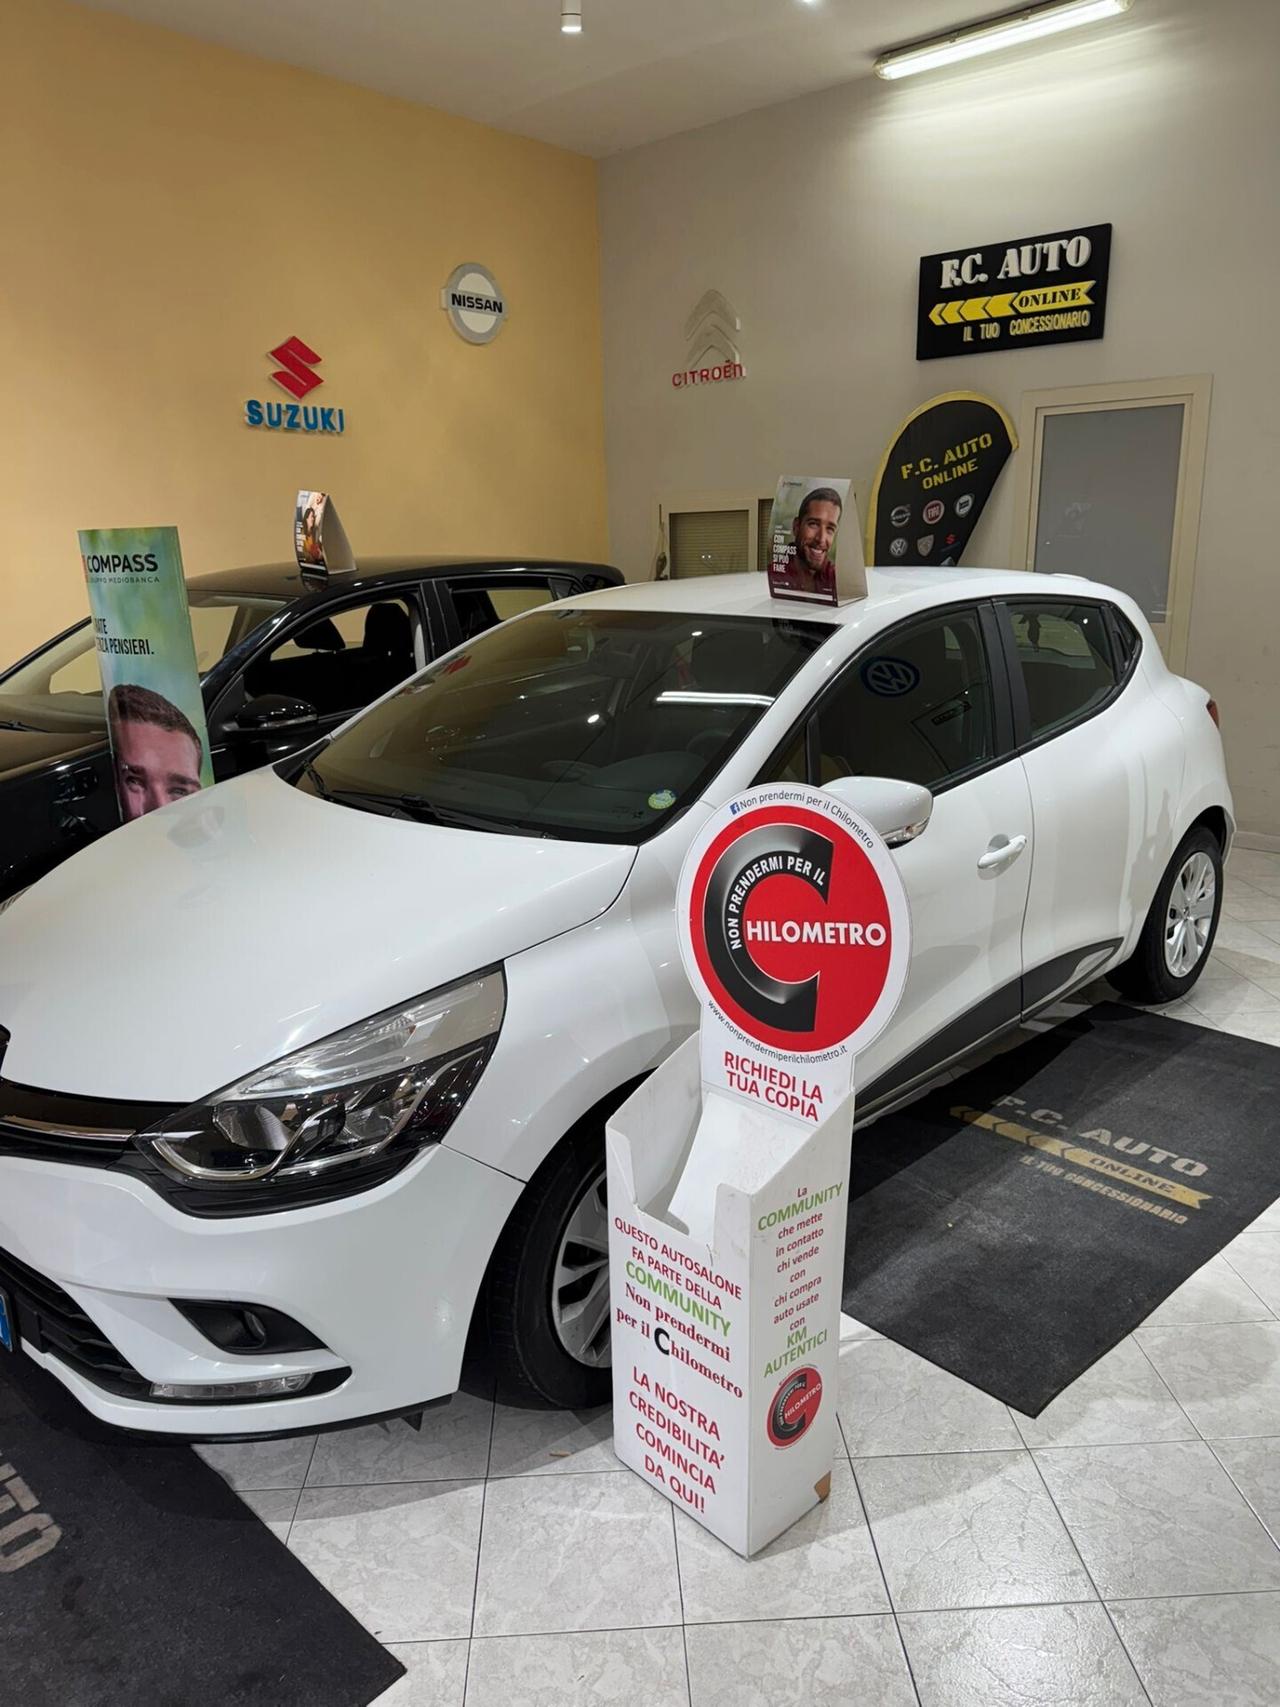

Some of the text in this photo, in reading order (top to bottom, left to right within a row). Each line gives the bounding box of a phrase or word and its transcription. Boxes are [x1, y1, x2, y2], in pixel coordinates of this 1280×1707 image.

[940, 235, 1092, 289] F.C. AUTO
[451, 293, 503, 313] NISSAN
[1018, 287, 1081, 308] ONLINE
[963, 309, 1091, 342] IL TUO CONCESSIONARIO
[245, 400, 346, 434] SUZUKI
[900, 433, 992, 480] F.C. AUTO
[922, 458, 979, 490] ONLINE
[86, 553, 159, 573] COMPASS
[109, 638, 155, 655] PENSIERI.
[739, 790, 875, 849] Non prendermi per il Chilometro
[727, 855, 826, 950] NON PRENDERMI PER IL
[708, 999, 848, 1065] www.nonprendermiperilchilometro.it
[724, 1050, 824, 1104] RICHIEDI LA
[726, 1069, 819, 1122] TUA COPIA
[1078, 1127, 1209, 1177] AUTO
[1088, 1157, 1178, 1194] ONLINE
[757, 1182, 843, 1231] COMMUNITY
[797, 1187, 807, 1198] La
[1034, 1160, 1064, 1177] TUO
[1064, 1172, 1189, 1225] CONCESSIONARIO
[775, 1228, 824, 1257] in contatto
[778, 1213, 823, 1239] che mette
[614, 1217, 742, 1300] QUESTO AUTOSALONE
[632, 1246, 722, 1310] FA PARTE DELLA
[777, 1246, 819, 1273] chi vende
[789, 1269, 806, 1283] con
[626, 1260, 731, 1337] COMMUNITY
[773, 1293, 819, 1324] auto usate
[774, 1276, 822, 1308] chi compra
[625, 1281, 731, 1363] Non prendermi
[786, 1326, 807, 1348] KM
[789, 1316, 805, 1331] con
[616, 1307, 743, 1398] per il Chilometro
[763, 1328, 828, 1378] AUTENTICI
[633, 1365, 720, 1441] LA NOSTRA
[636, 1422, 716, 1495] COMINCIA
[644, 1454, 705, 1514] DA QUI!
